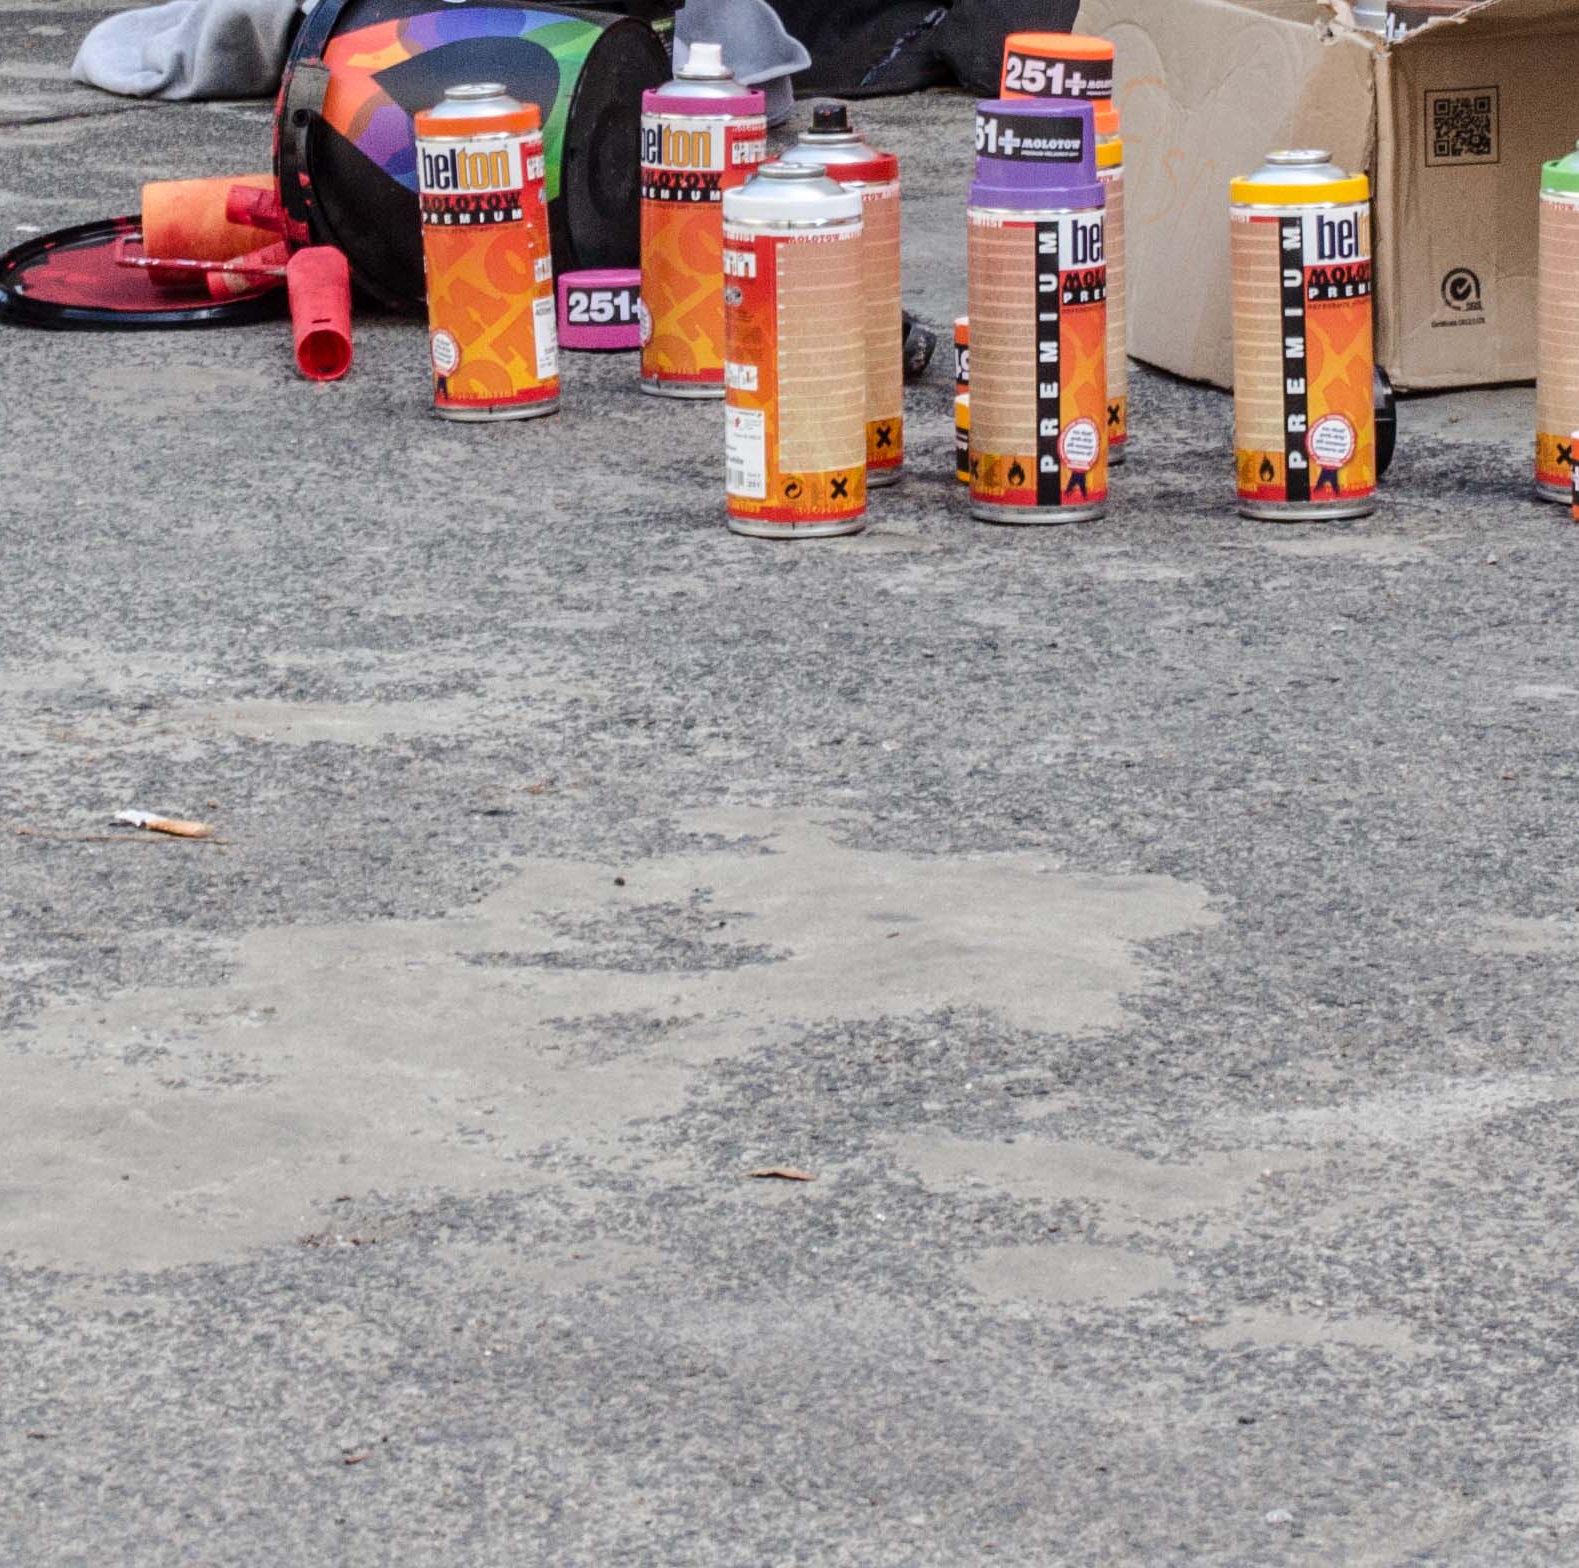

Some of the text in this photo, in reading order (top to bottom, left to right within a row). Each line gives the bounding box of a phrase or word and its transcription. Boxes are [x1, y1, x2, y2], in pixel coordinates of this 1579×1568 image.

[1005, 55, 1087, 96] 251+
[1022, 137, 1082, 149] MOLOTOW
[422, 145, 511, 190] belton
[422, 208, 522, 225] PREMIUM
[1038, 231, 1060, 474] PREMIUM
[1282, 226, 1308, 470] PREMIUM
